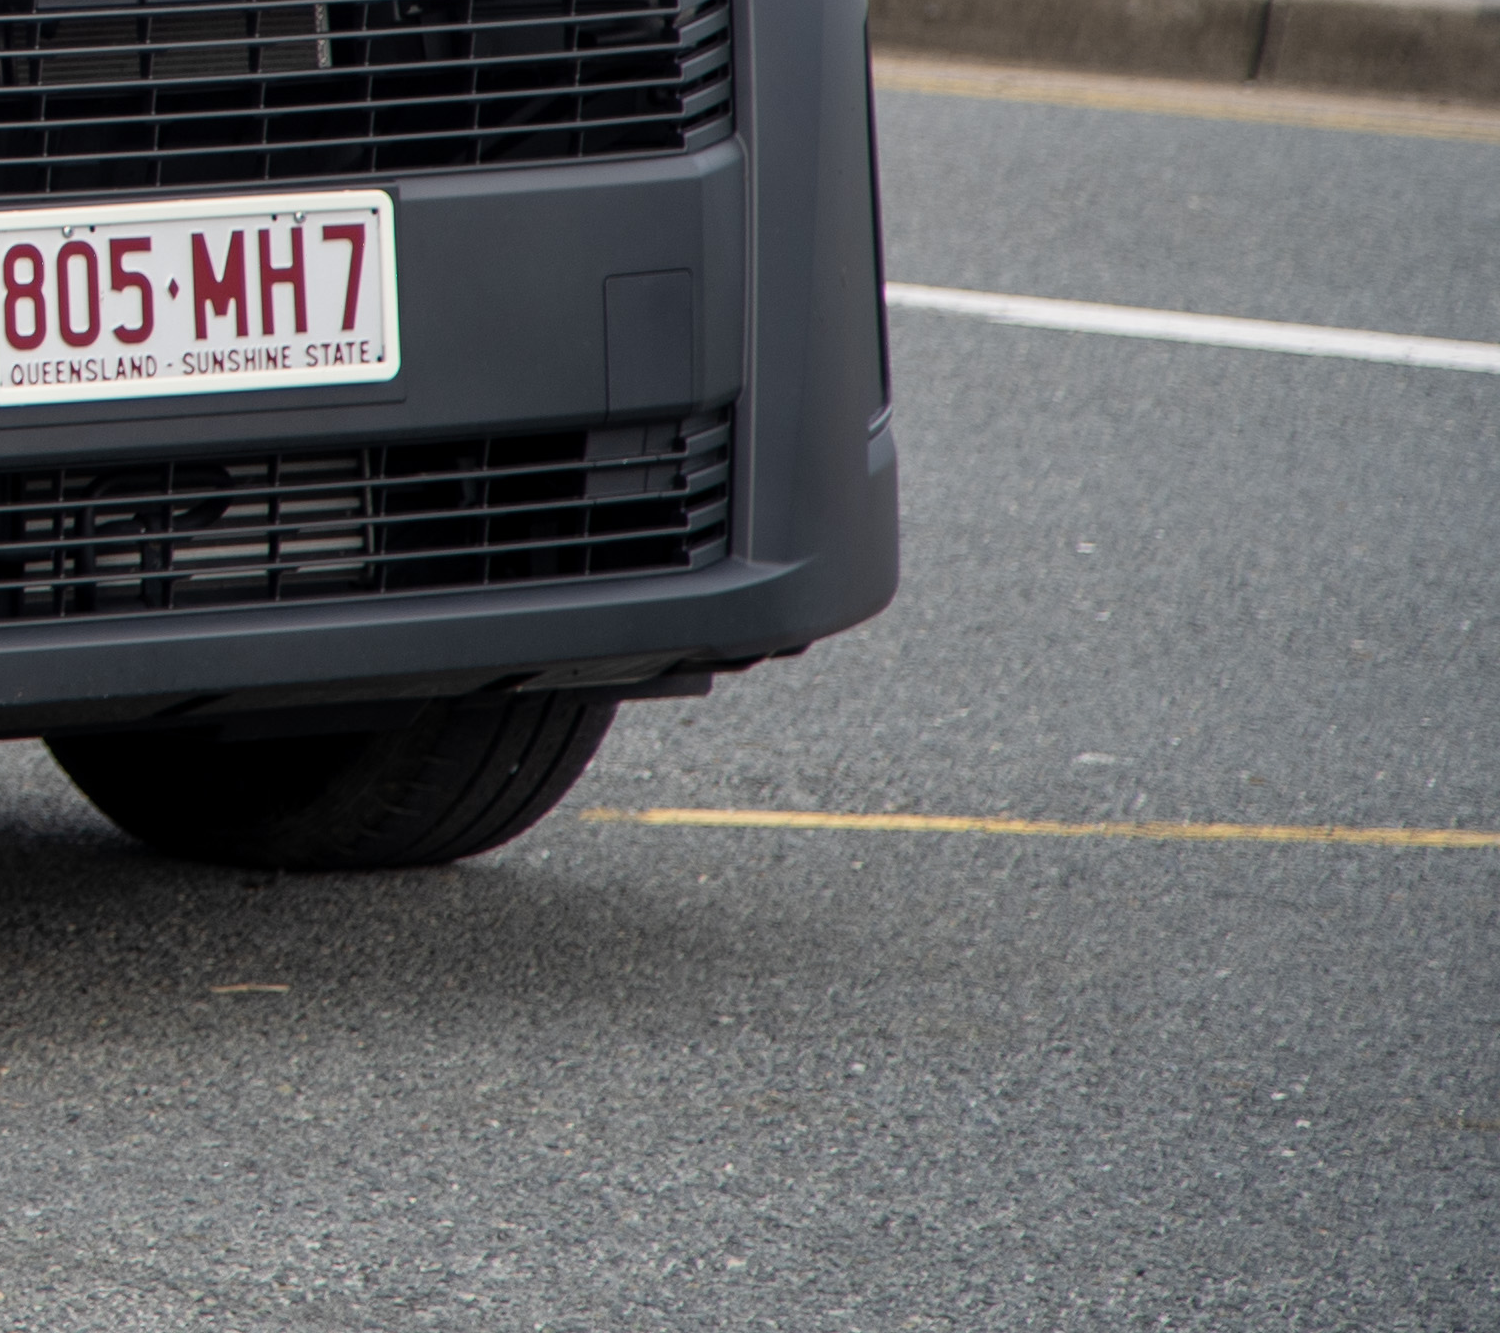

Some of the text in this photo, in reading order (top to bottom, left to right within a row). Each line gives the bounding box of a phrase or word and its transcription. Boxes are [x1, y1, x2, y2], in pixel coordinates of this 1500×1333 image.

[10, 354, 158, 386] QUEENSLAND
[181, 345, 293, 376] SUNSHINE
[305, 340, 371, 368] STATE
